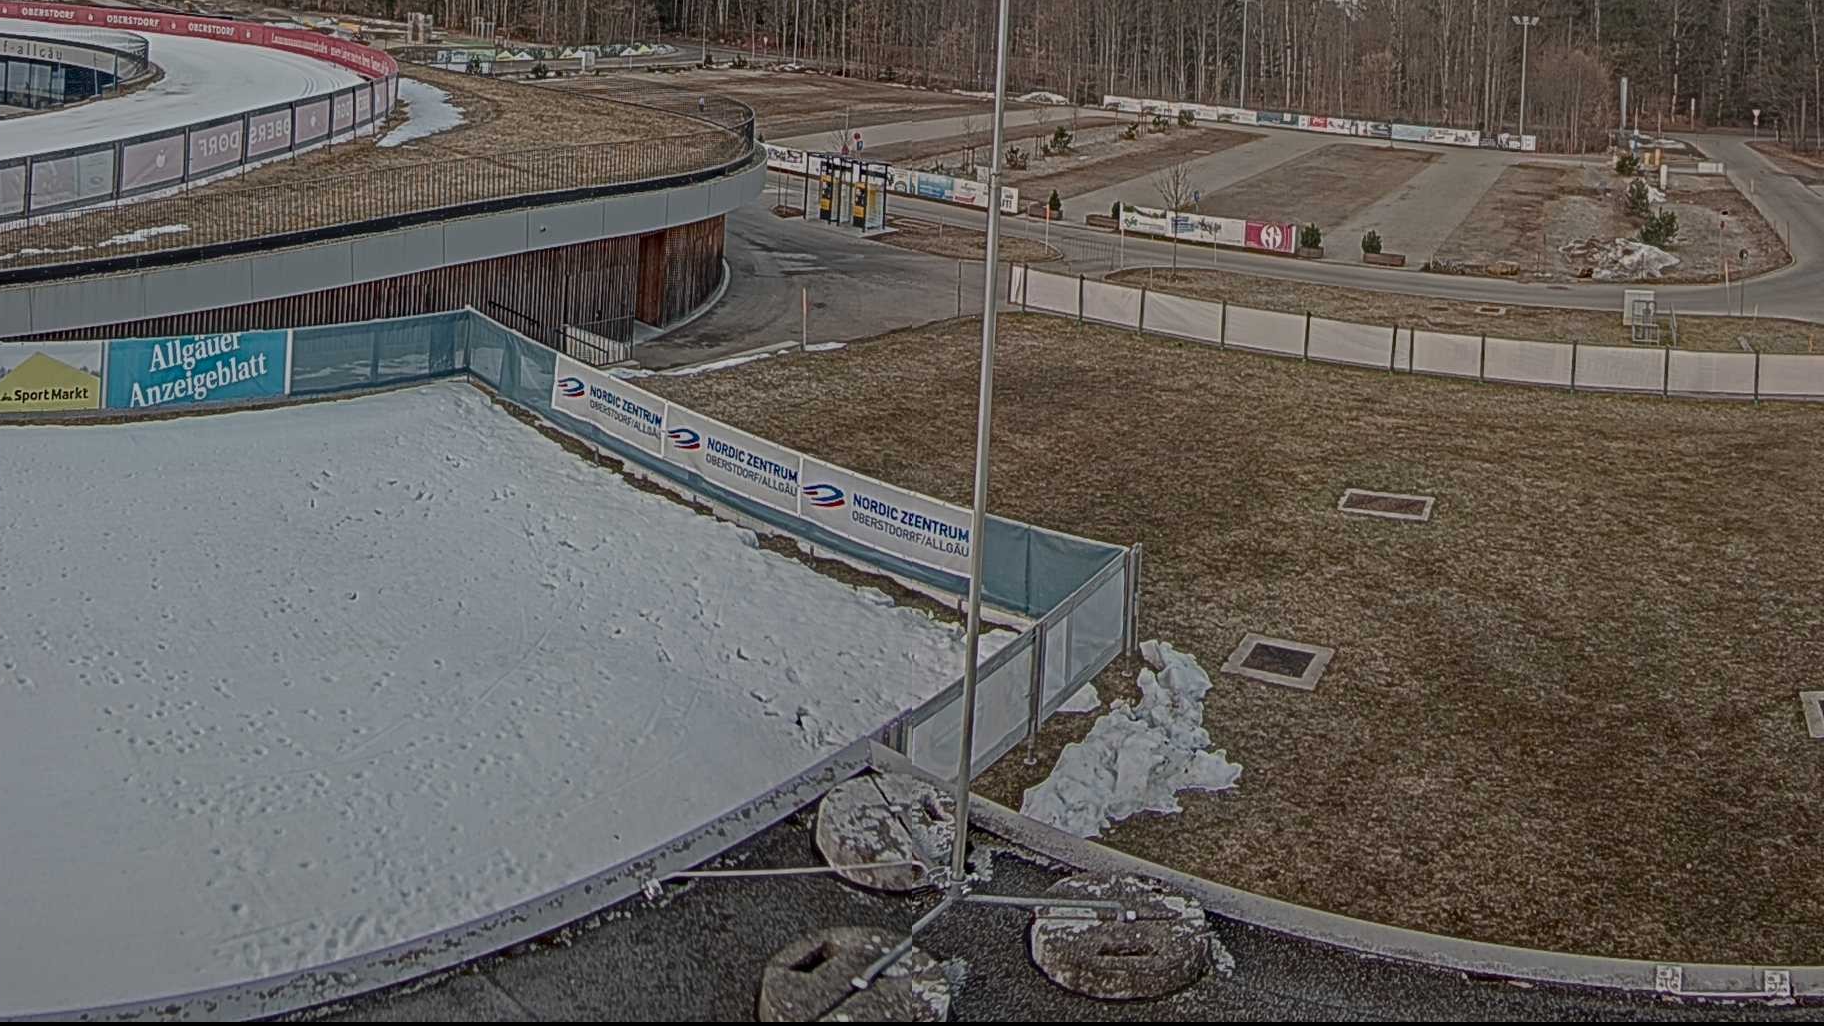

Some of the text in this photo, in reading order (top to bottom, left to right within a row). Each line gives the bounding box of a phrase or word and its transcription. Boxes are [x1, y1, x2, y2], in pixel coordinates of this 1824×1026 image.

[21, 7, 75, 19] OBERSTDORF
[106, 14, 160, 27] OBERSTDORF
[188, 22, 235, 36] OBERSTDORF
[149, 333, 242, 371] Allgäuer
[130, 352, 268, 408] Anzeigeblatt
[589, 384, 663, 428] NORDIC ZENTRUM
[705, 453, 798, 497] OBERSTDORF/ALLGÄU
[707, 437, 799, 484] NORDIC ZENTRUM
[853, 493, 899, 521] NORDIC
